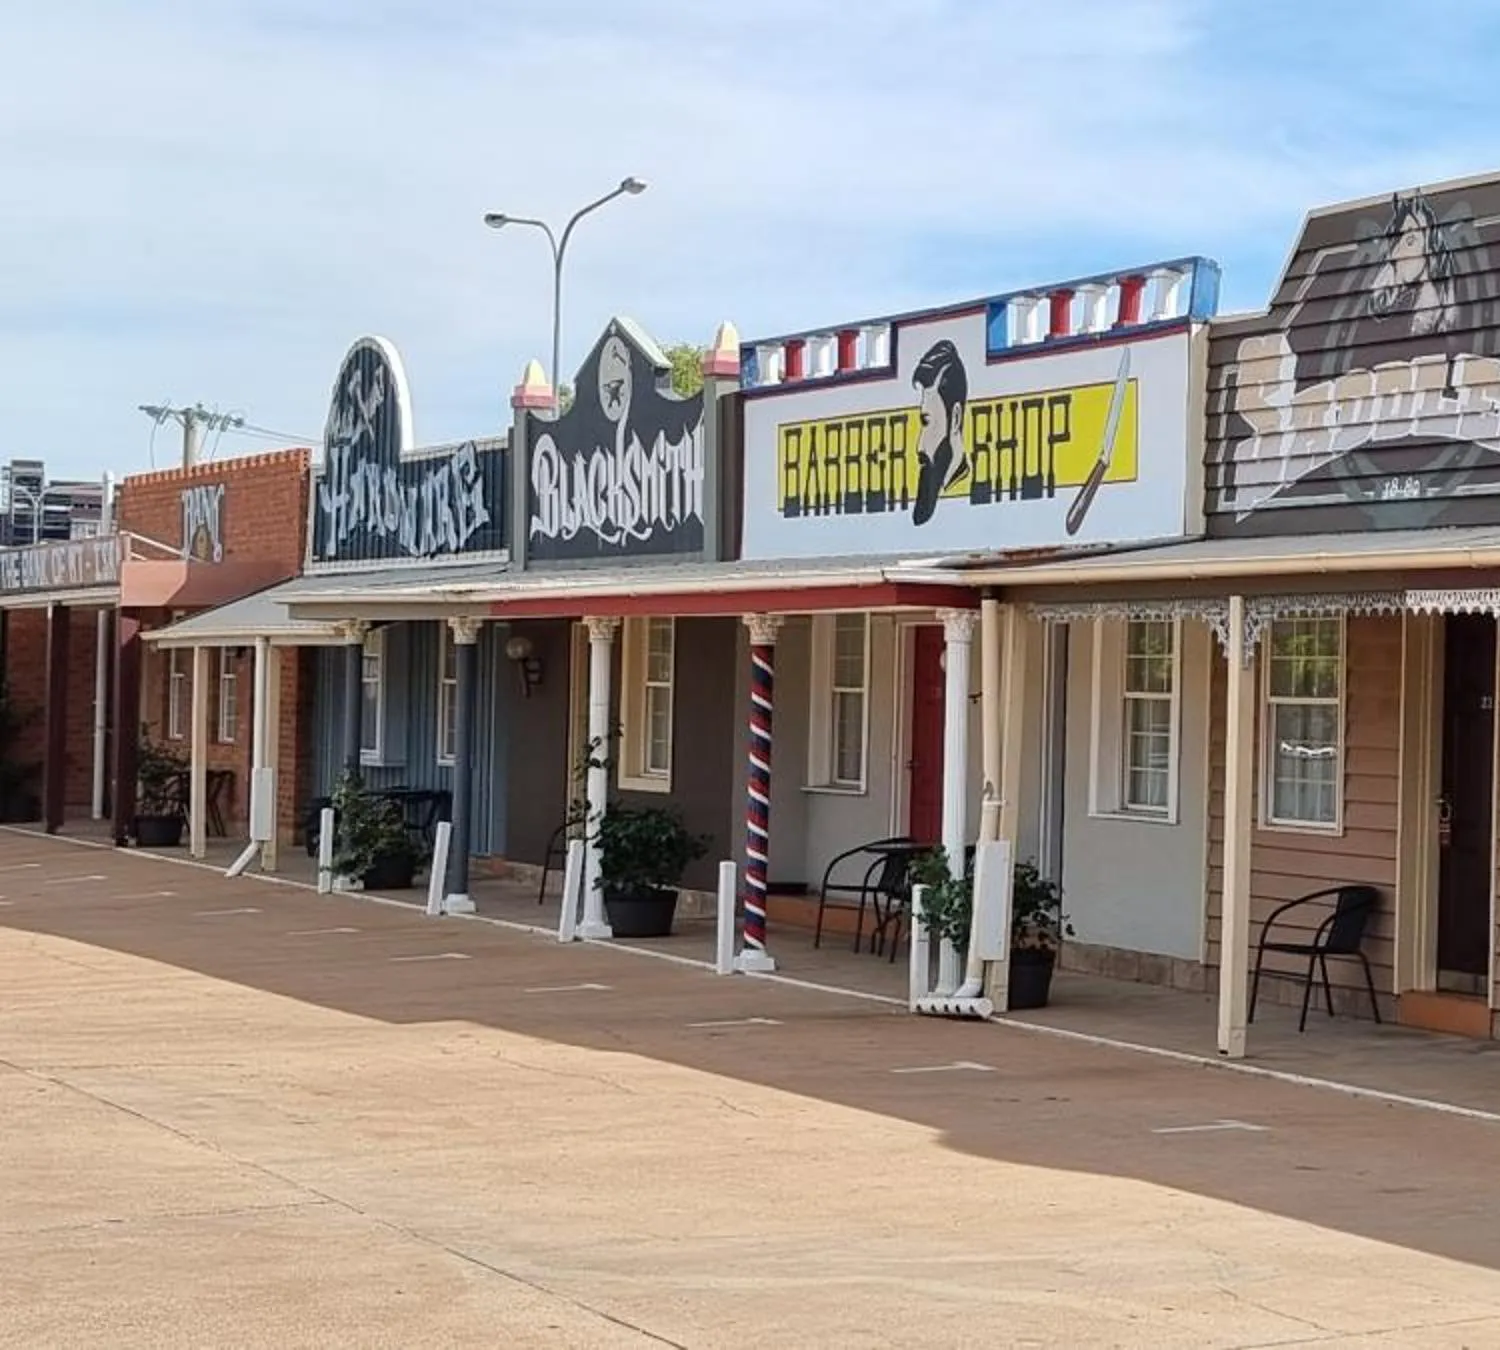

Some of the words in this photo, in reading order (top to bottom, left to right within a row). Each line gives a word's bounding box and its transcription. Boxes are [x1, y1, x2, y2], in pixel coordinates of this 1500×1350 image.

[529, 405, 705, 547] BLACKSMITH
[783, 413, 910, 518] BARBER
[969, 394, 1073, 505] SHOP
